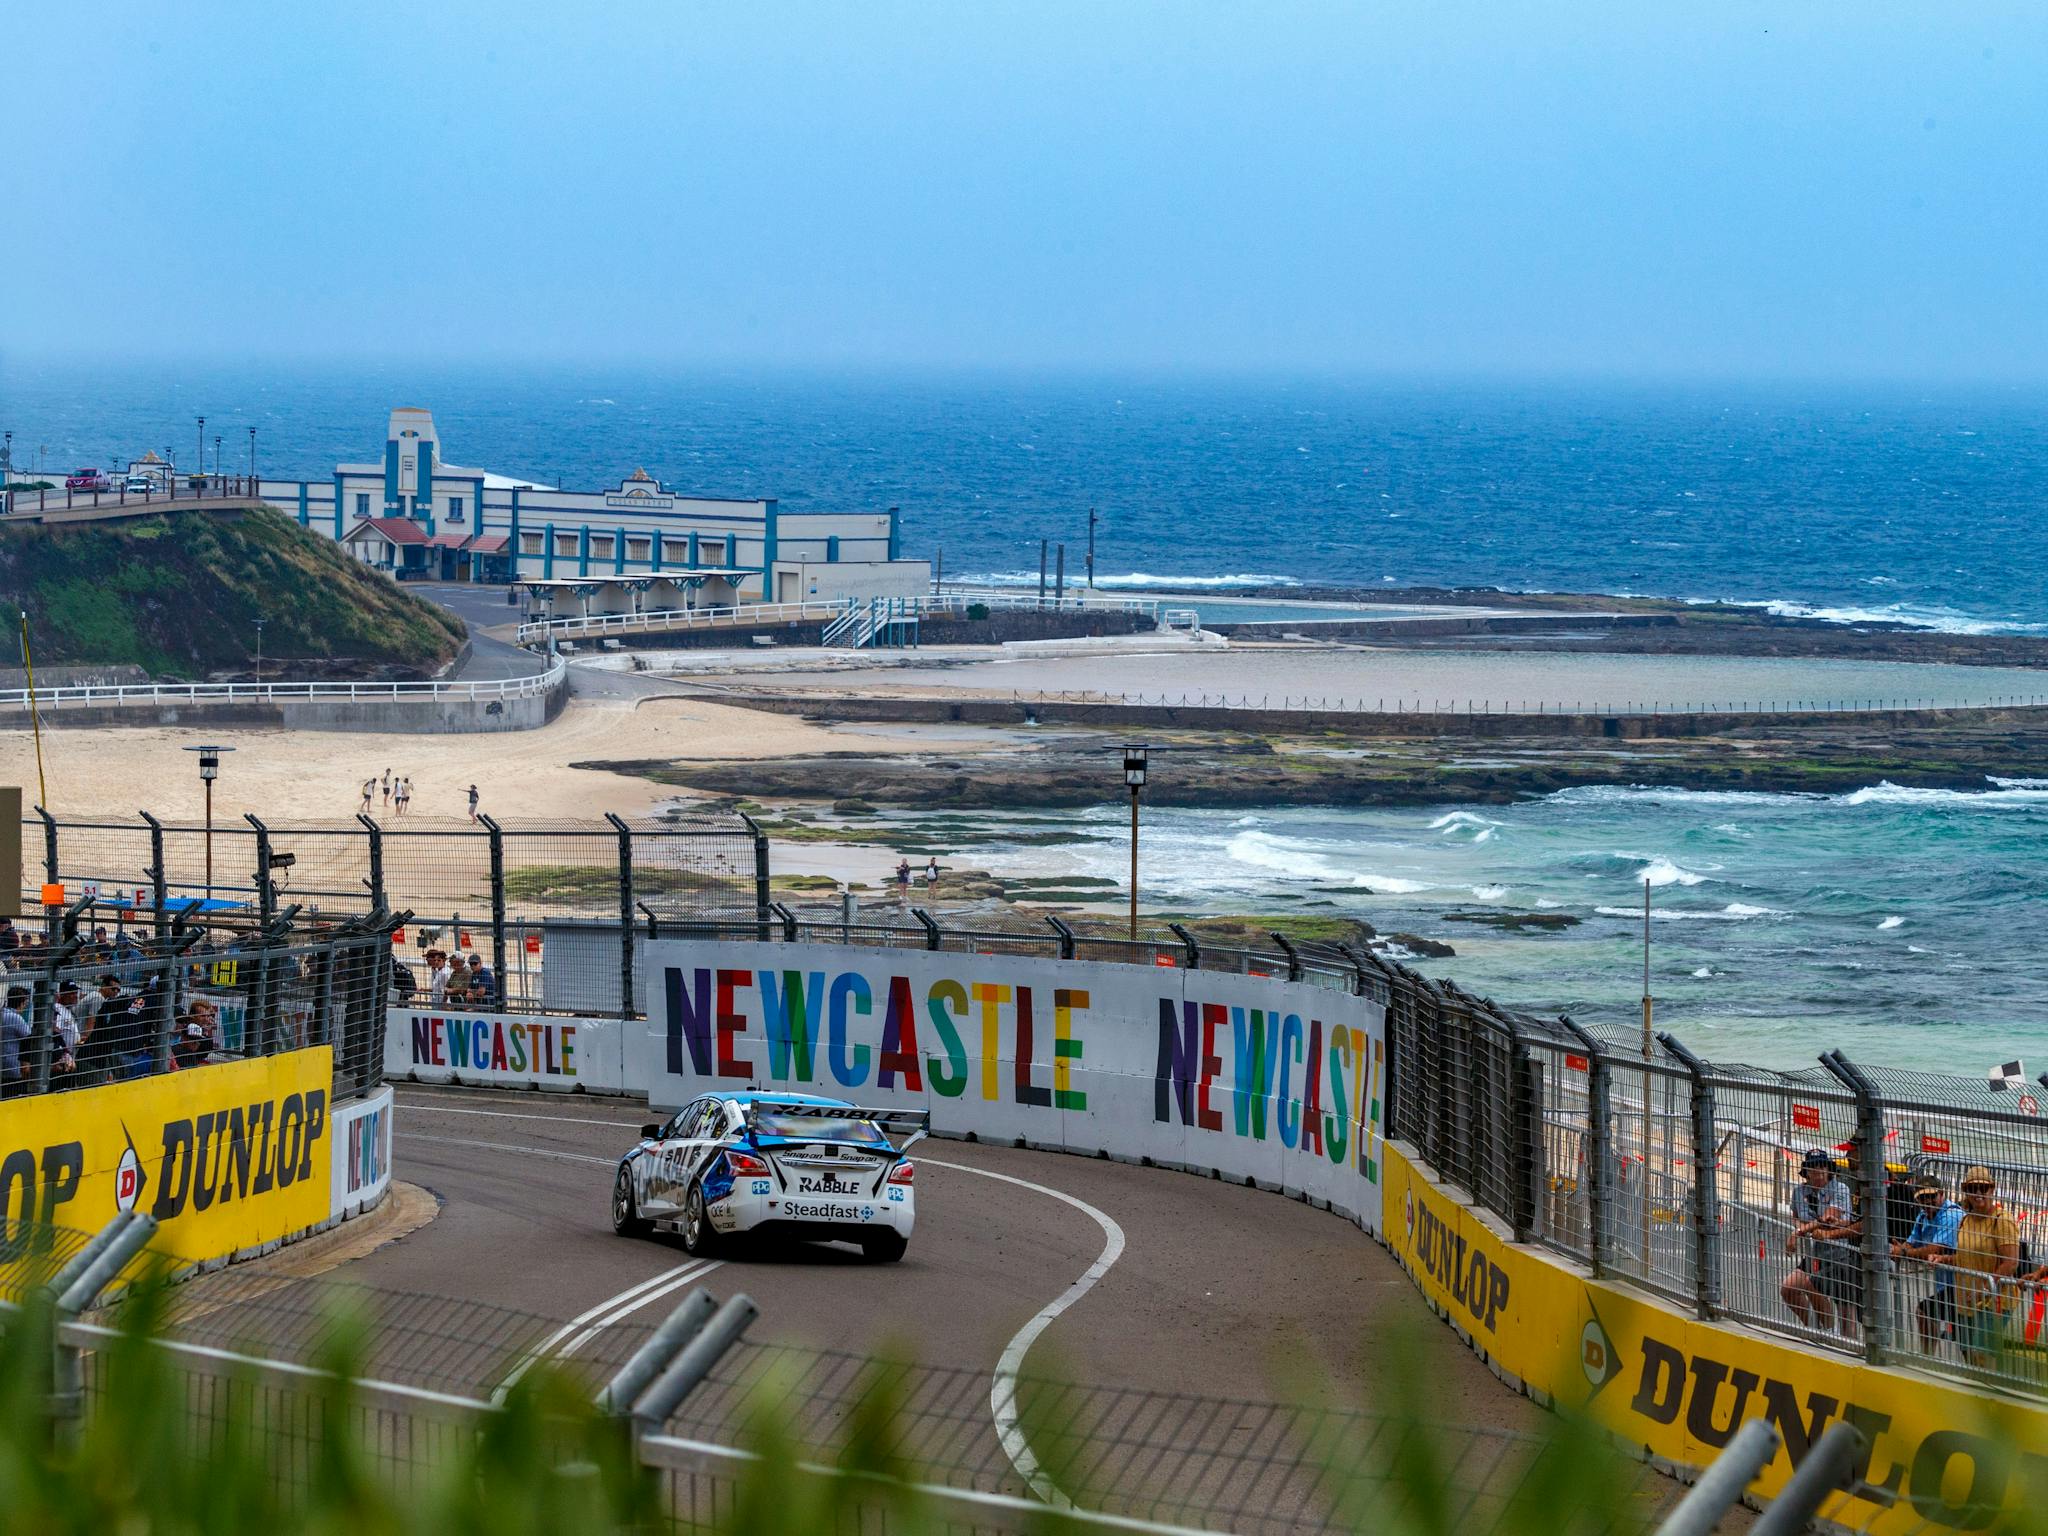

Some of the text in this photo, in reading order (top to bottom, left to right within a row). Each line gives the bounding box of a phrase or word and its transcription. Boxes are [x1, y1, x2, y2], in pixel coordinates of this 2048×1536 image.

[84, 886, 96, 895] 5.1
[135, 889, 146, 905] F
[412, 1017, 576, 1076] NEWCASTLE
[664, 967, 1090, 1111] NEWCASTLE
[1155, 998, 1383, 1185] NEWCASTLE
[772, 1104, 907, 1121] RABBLE
[152, 1089, 325, 1221] DUNLOP
[120, 1169, 135, 1199] D
[752, 1181, 769, 1194] PPG
[799, 1176, 860, 1195] RABBLE
[784, 1201, 859, 1219] Steadfast
[1416, 1198, 1510, 1335] DUNLOP
[1584, 1339, 1605, 1371] D
